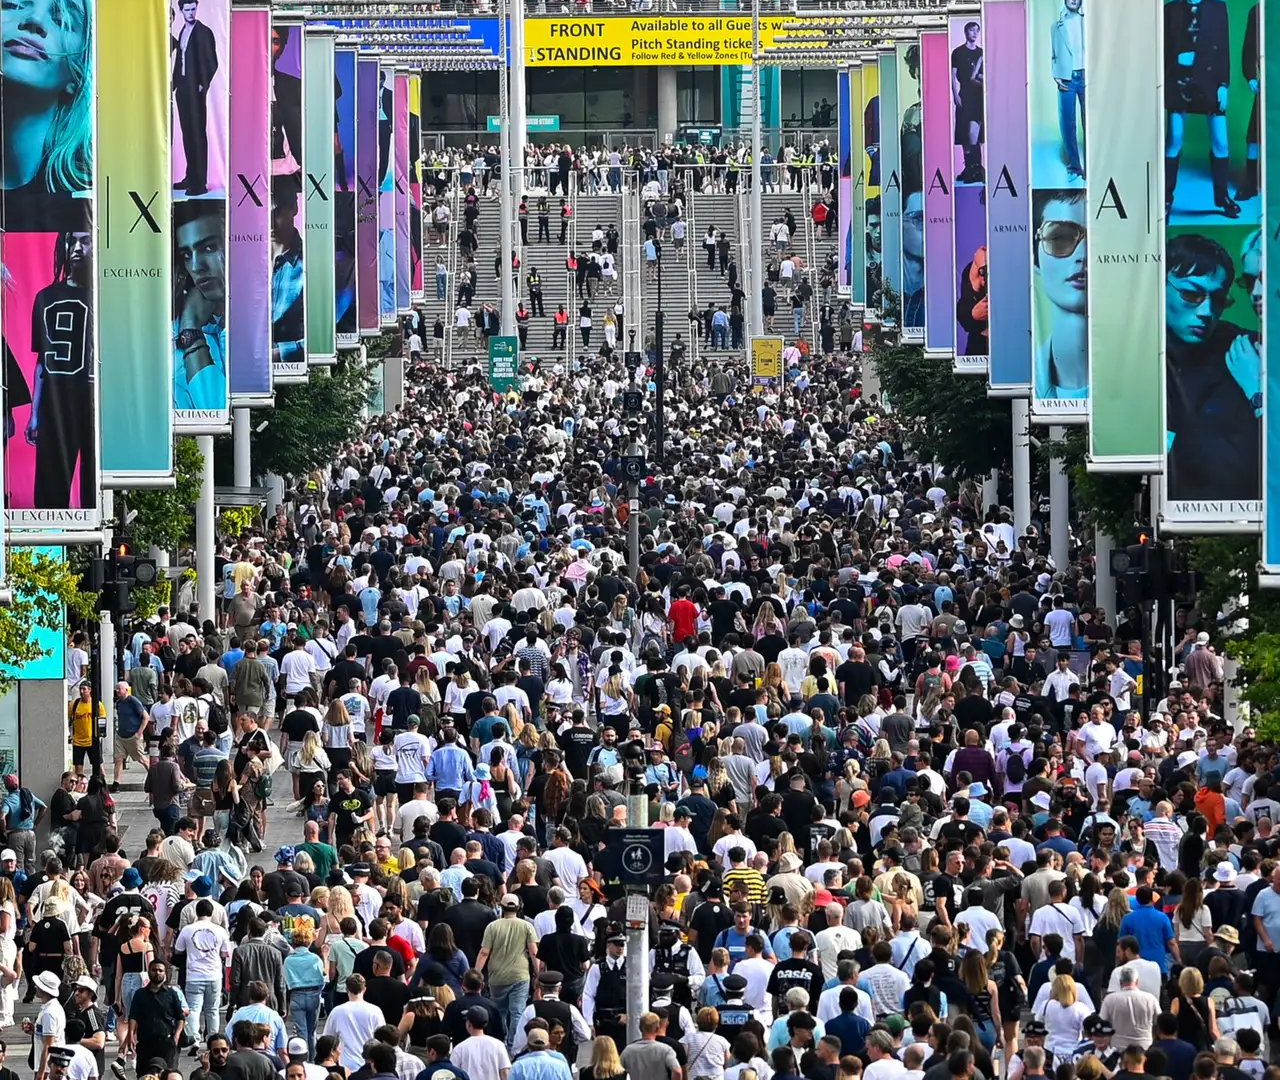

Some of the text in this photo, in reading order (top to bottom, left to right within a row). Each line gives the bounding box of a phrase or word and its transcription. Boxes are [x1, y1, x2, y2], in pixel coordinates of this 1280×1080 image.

[550, 23, 605, 37] FRONT
[631, 19, 688, 31] Available
[691, 21, 705, 31] to
[708, 19, 723, 31] all
[726, 19, 768, 31] Guets
[631, 37, 763, 52] Pitch Standing tickes
[537, 46, 621, 61] STANDING
[631, 51, 658, 59] Follow
[661, 51, 676, 59] Red
[687, 51, 713, 59] Yellow
[715, 51, 738, 59] Zones
[307, 173, 329, 201] X
[927, 167, 950, 196] A
[992, 164, 1019, 199] A
[237, 173, 264, 207] X
[993, 224, 1027, 233] ARMANI
[1096, 254, 1139, 264] ARMANI
[103, 268, 163, 278] EXCHANGE
[44, 299, 89, 375] 9
[1041, 400, 1078, 408] ARMANI
[1175, 502, 1223, 513] ARMANI
[21, 510, 90, 521] EXCHANGE
[776, 968, 813, 980] oasis
[721, 1015, 748, 1025] POLICE
